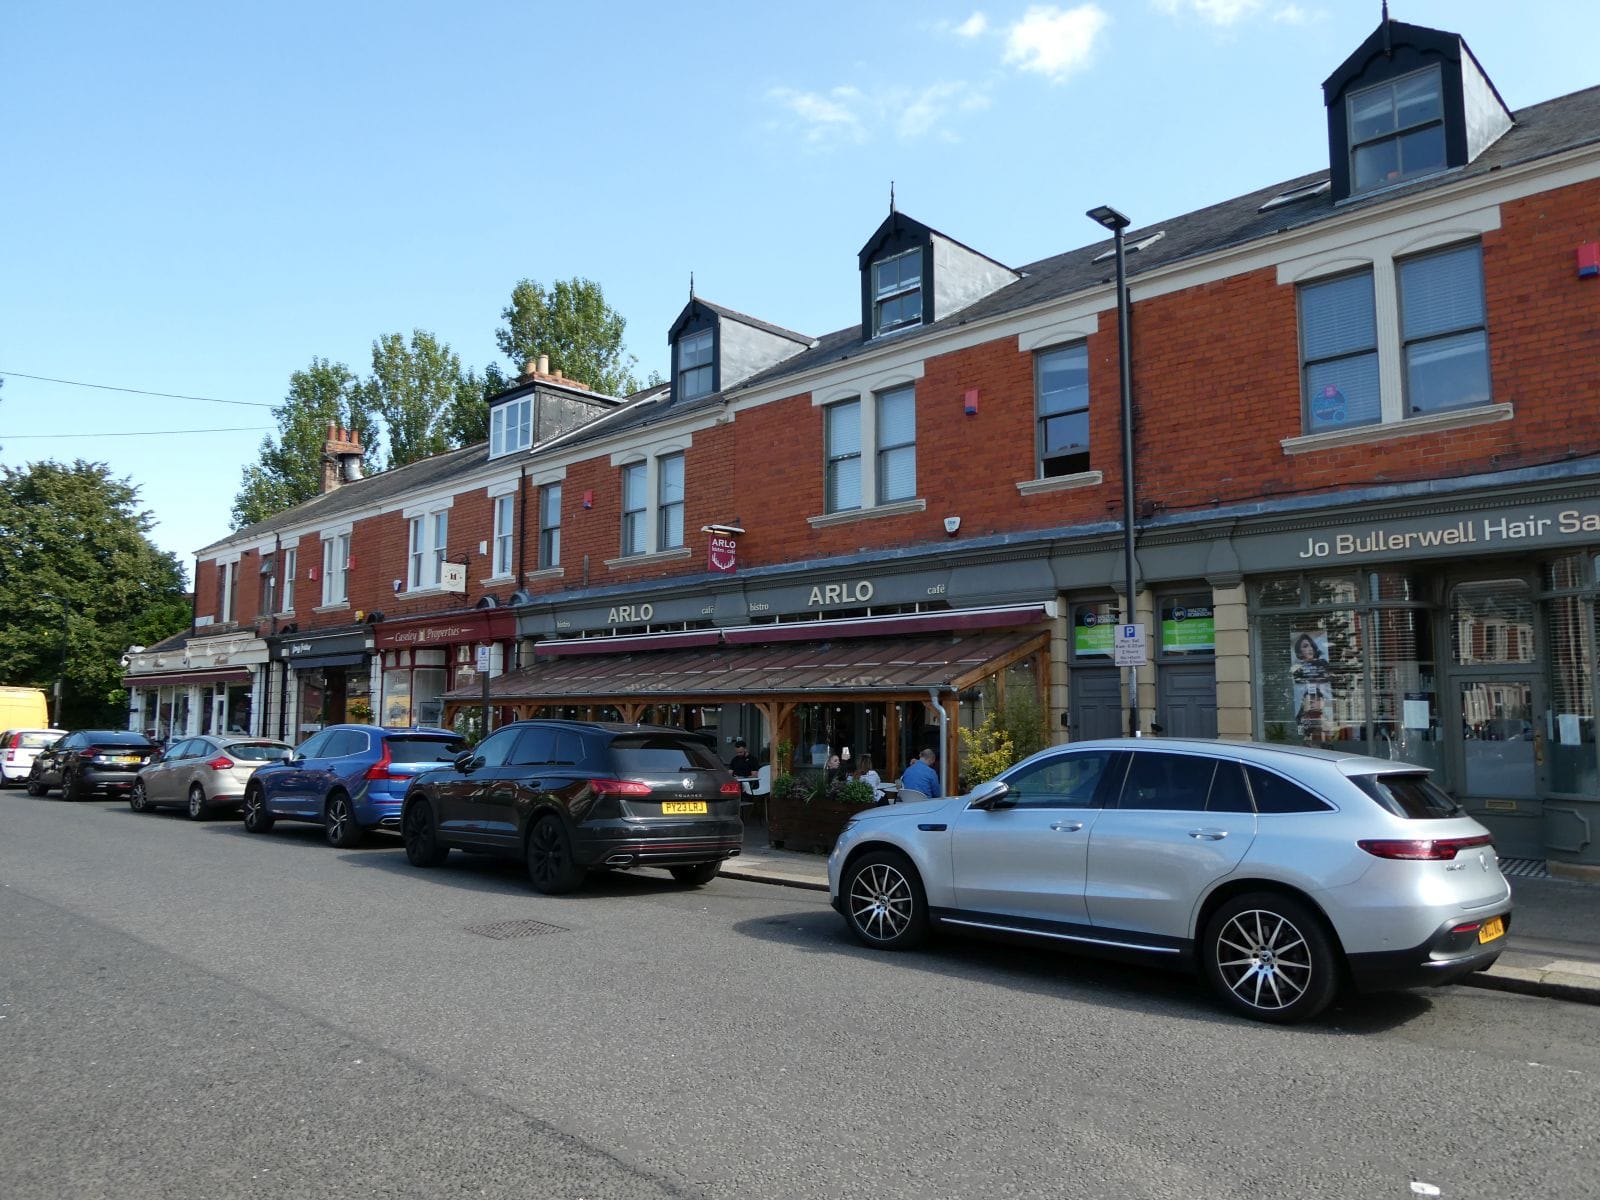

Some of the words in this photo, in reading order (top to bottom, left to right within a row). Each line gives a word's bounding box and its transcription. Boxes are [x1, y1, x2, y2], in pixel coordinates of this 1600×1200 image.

[711, 538, 736, 549] ARLO
[1299, 537, 1329, 558] Jo
[1335, 519, 1477, 555] Bullerwell
[1483, 514, 1552, 541] Hair
[1557, 510, 1600, 533] Sa
[749, 602, 769, 612] bistro
[807, 580, 874, 606] ARLO
[926, 583, 945, 595] café
[607, 603, 654, 624] ARLO
[395, 630, 418, 644] Caseley
[426, 625, 460, 640] Properties
